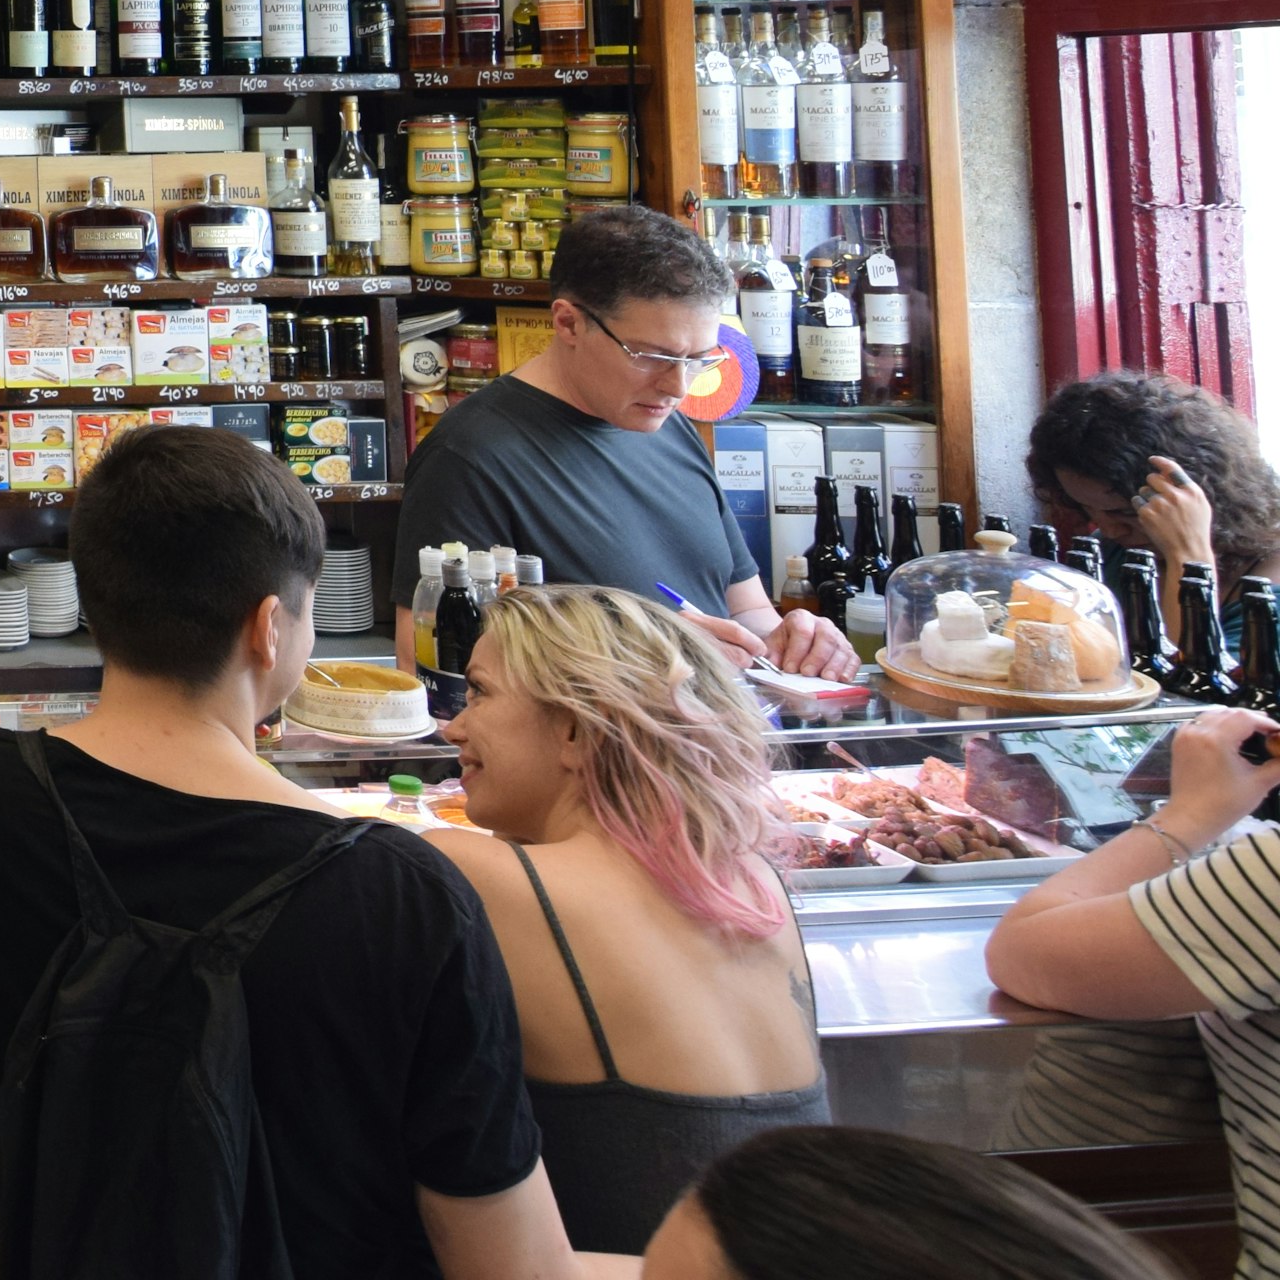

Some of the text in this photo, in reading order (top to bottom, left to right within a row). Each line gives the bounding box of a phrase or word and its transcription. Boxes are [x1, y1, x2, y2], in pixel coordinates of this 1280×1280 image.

[415, 72, 449, 86] 72'40
[555, 69, 588, 82] 46'00
[179, 78, 214, 92] 350'00
[145, 118, 224, 131] XIMÉNEZ-SPÍNOLA
[236, 307, 262, 316] Almejas
[170, 314, 205, 327] Almejas
[33, 350, 63, 358] Navajas
[98, 348, 127, 357] Almejas
[92, 387, 125, 400] 21'90
[233, 385, 265, 399] 14'90
[286, 409, 330, 418] BERBERECHOS
[38, 452, 71, 460] Berberechos
[289, 448, 332, 457] BERBERECHOS
